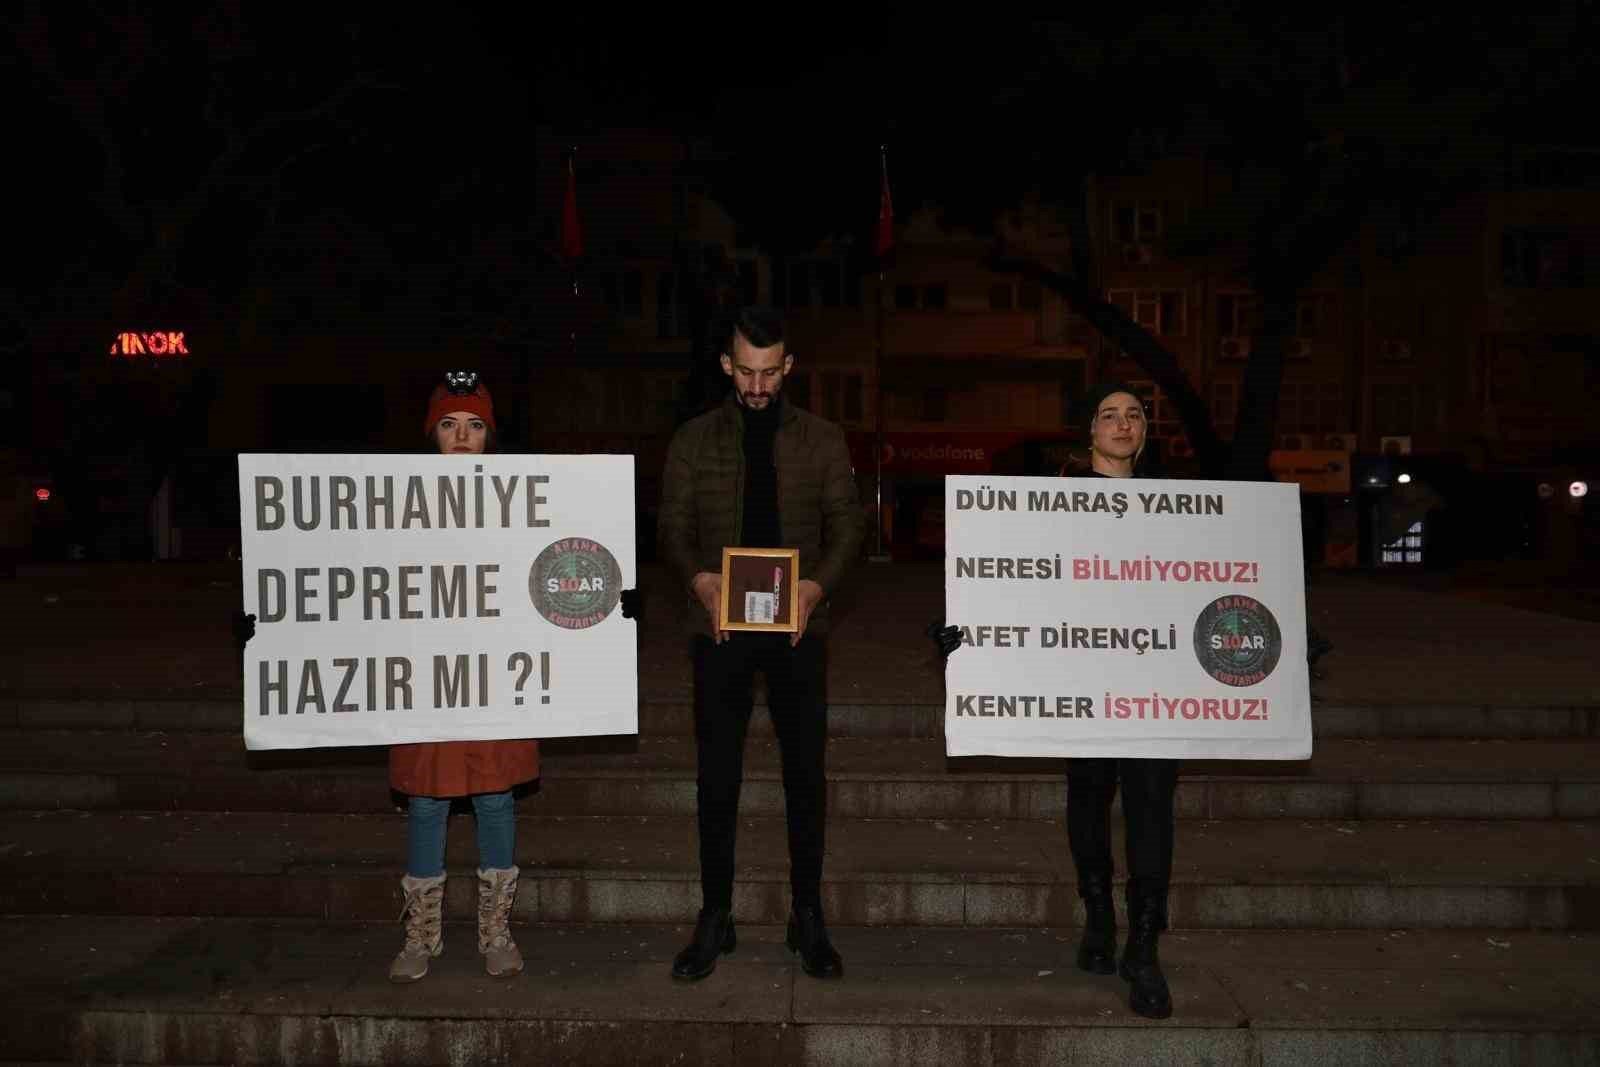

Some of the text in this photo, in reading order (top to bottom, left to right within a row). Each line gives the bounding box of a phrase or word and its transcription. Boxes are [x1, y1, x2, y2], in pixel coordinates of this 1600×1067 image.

[901, 441, 986, 462] vodafone
[254, 465, 551, 532] BURHANİYE
[956, 485, 1224, 519] DÜN MARAŞ YARIN
[955, 553, 1259, 584] NERESİ BİLMİYORUZ!
[257, 564, 501, 624] DEPREME
[959, 621, 1177, 656] AFET DİRENÇLİ
[258, 651, 551, 717] HAZIR MI ?!
[956, 691, 1269, 721] KENTLER İSTİYORUZ!
